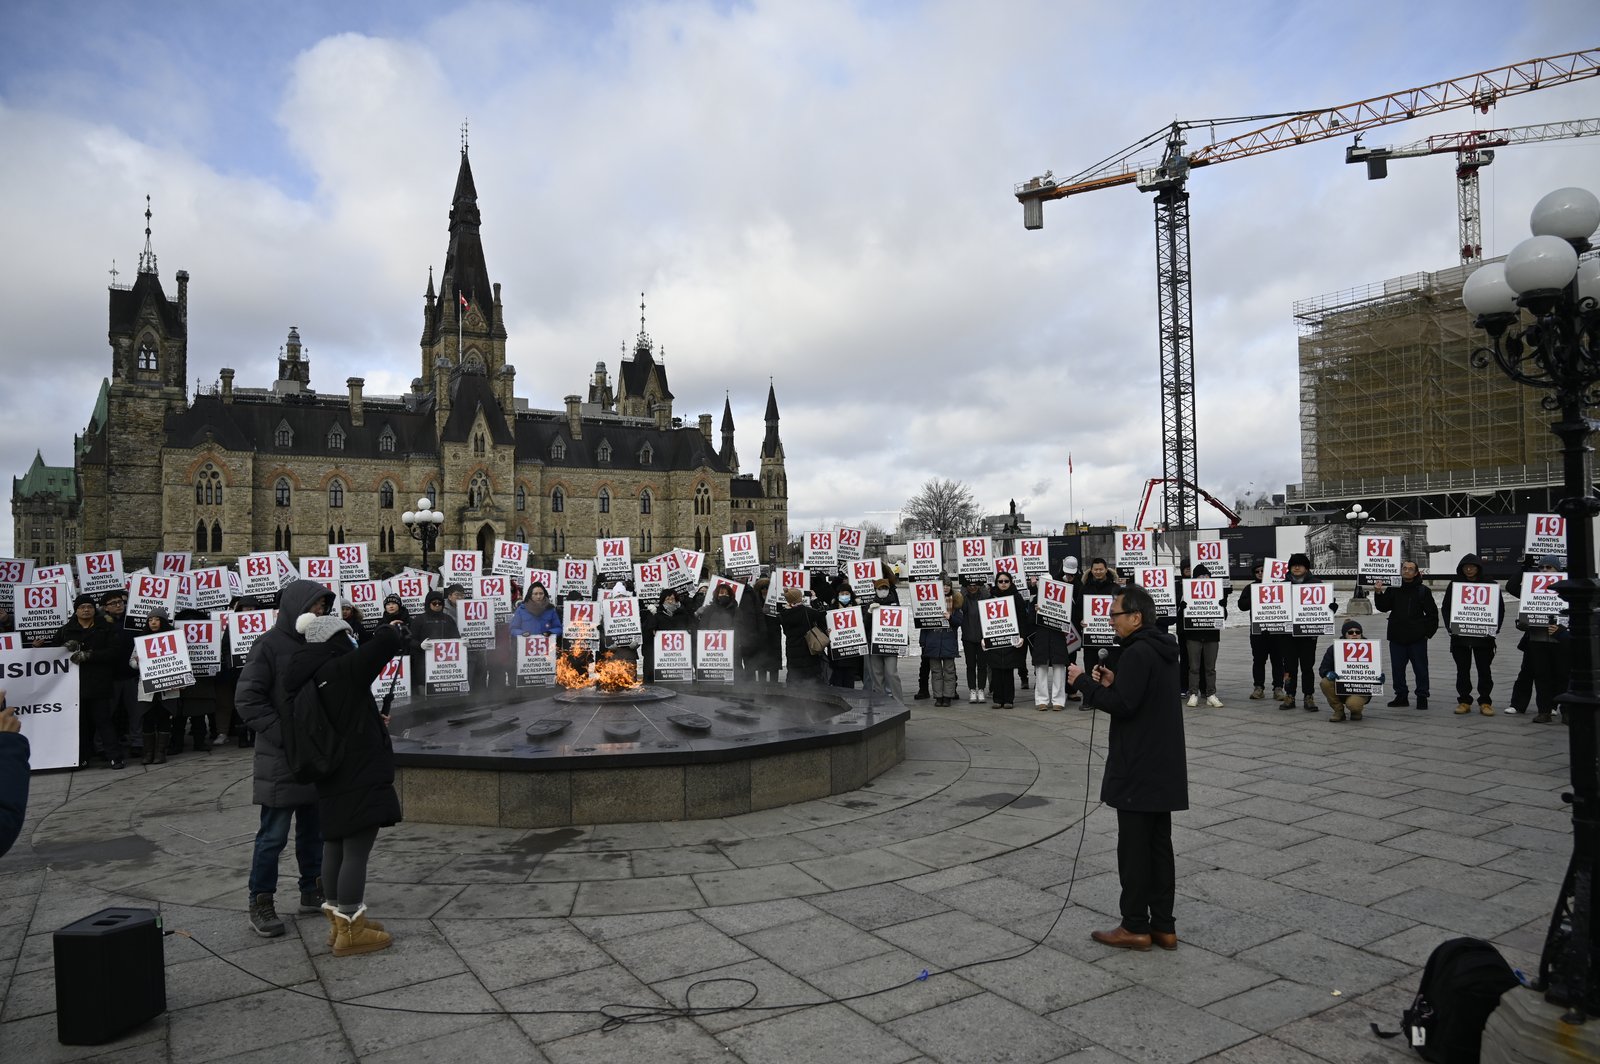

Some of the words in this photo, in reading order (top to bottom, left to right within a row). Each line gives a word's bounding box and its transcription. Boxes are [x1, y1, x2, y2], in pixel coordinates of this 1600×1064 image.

[1538, 517, 1559, 535] 19
[732, 536, 748, 551] 70
[812, 534, 830, 549] 36
[841, 530, 858, 546] 28
[1125, 535, 1143, 550] 32
[339, 547, 359, 563] 38
[503, 544, 519, 559] 18
[605, 541, 623, 556] 27
[916, 543, 933, 558] 90
[966, 540, 982, 556] 39
[1024, 541, 1040, 556] 37
[1200, 543, 1218, 559] 30
[1370, 539, 1390, 556] 37
[89, 556, 112, 573] 34
[167, 556, 183, 571] 27
[250, 558, 268, 576] 33
[310, 561, 330, 577] 34
[456, 554, 473, 571] 65
[568, 563, 584, 579] 63
[857, 562, 874, 578] 37
[998, 558, 1017, 573] 32
[0, 563, 20, 582] 68
[198, 571, 219, 590] 27
[643, 566, 660, 582] 35
[786, 572, 800, 587] 31
[1145, 570, 1165, 587] 38
[142, 578, 165, 597] 39
[354, 584, 373, 601] 30
[402, 579, 420, 596] 55
[484, 579, 501, 596] 62
[919, 585, 936, 601] 31
[1046, 582, 1064, 602] 37
[1194, 582, 1213, 598] 40
[1263, 586, 1282, 603] 31
[1303, 587, 1323, 604] 20
[1464, 586, 1487, 604] 30
[28, 588, 58, 608] 68
[467, 602, 487, 619] 40
[575, 604, 590, 621] 72
[613, 601, 632, 617] 23
[989, 601, 1005, 618] 37
[1094, 598, 1112, 616] 37
[242, 615, 264, 633] 33
[836, 611, 854, 629] 37
[883, 609, 900, 626] 37
[187, 625, 209, 642] 81
[664, 634, 682, 650] 36
[707, 634, 725, 650] 21
[150, 636, 173, 656] 41
[437, 642, 457, 660] 34
[528, 638, 547, 656] 35
[1346, 643, 1369, 662] 22
[158, 666, 188, 674] RESPONSE
